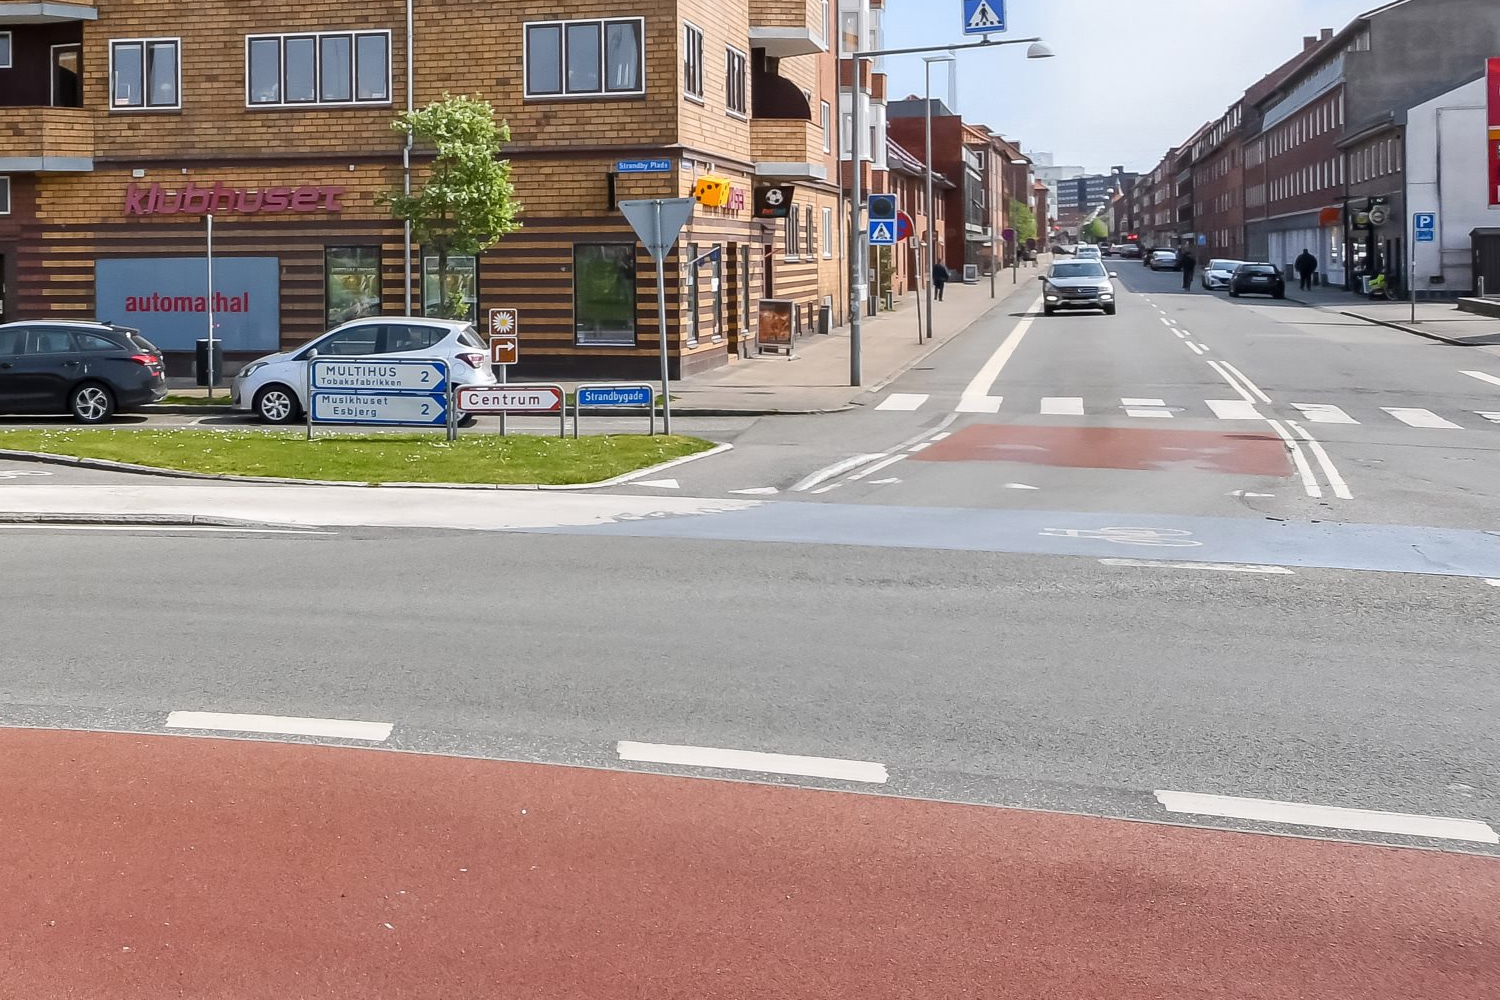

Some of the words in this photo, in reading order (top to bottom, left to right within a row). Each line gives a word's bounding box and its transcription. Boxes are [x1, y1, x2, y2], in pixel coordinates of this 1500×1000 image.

[125, 182, 344, 214] klubhuset
[325, 366, 397, 377] MULTIHUS
[420, 371, 430, 382] 2
[321, 377, 402, 386] Tobaksfabrikken
[468, 393, 541, 406] Centrum
[585, 391, 644, 403] Strandbygade
[322, 395, 388, 406] Musikhuset
[420, 403, 430, 415] 2
[333, 406, 377, 417] Esbjerg
